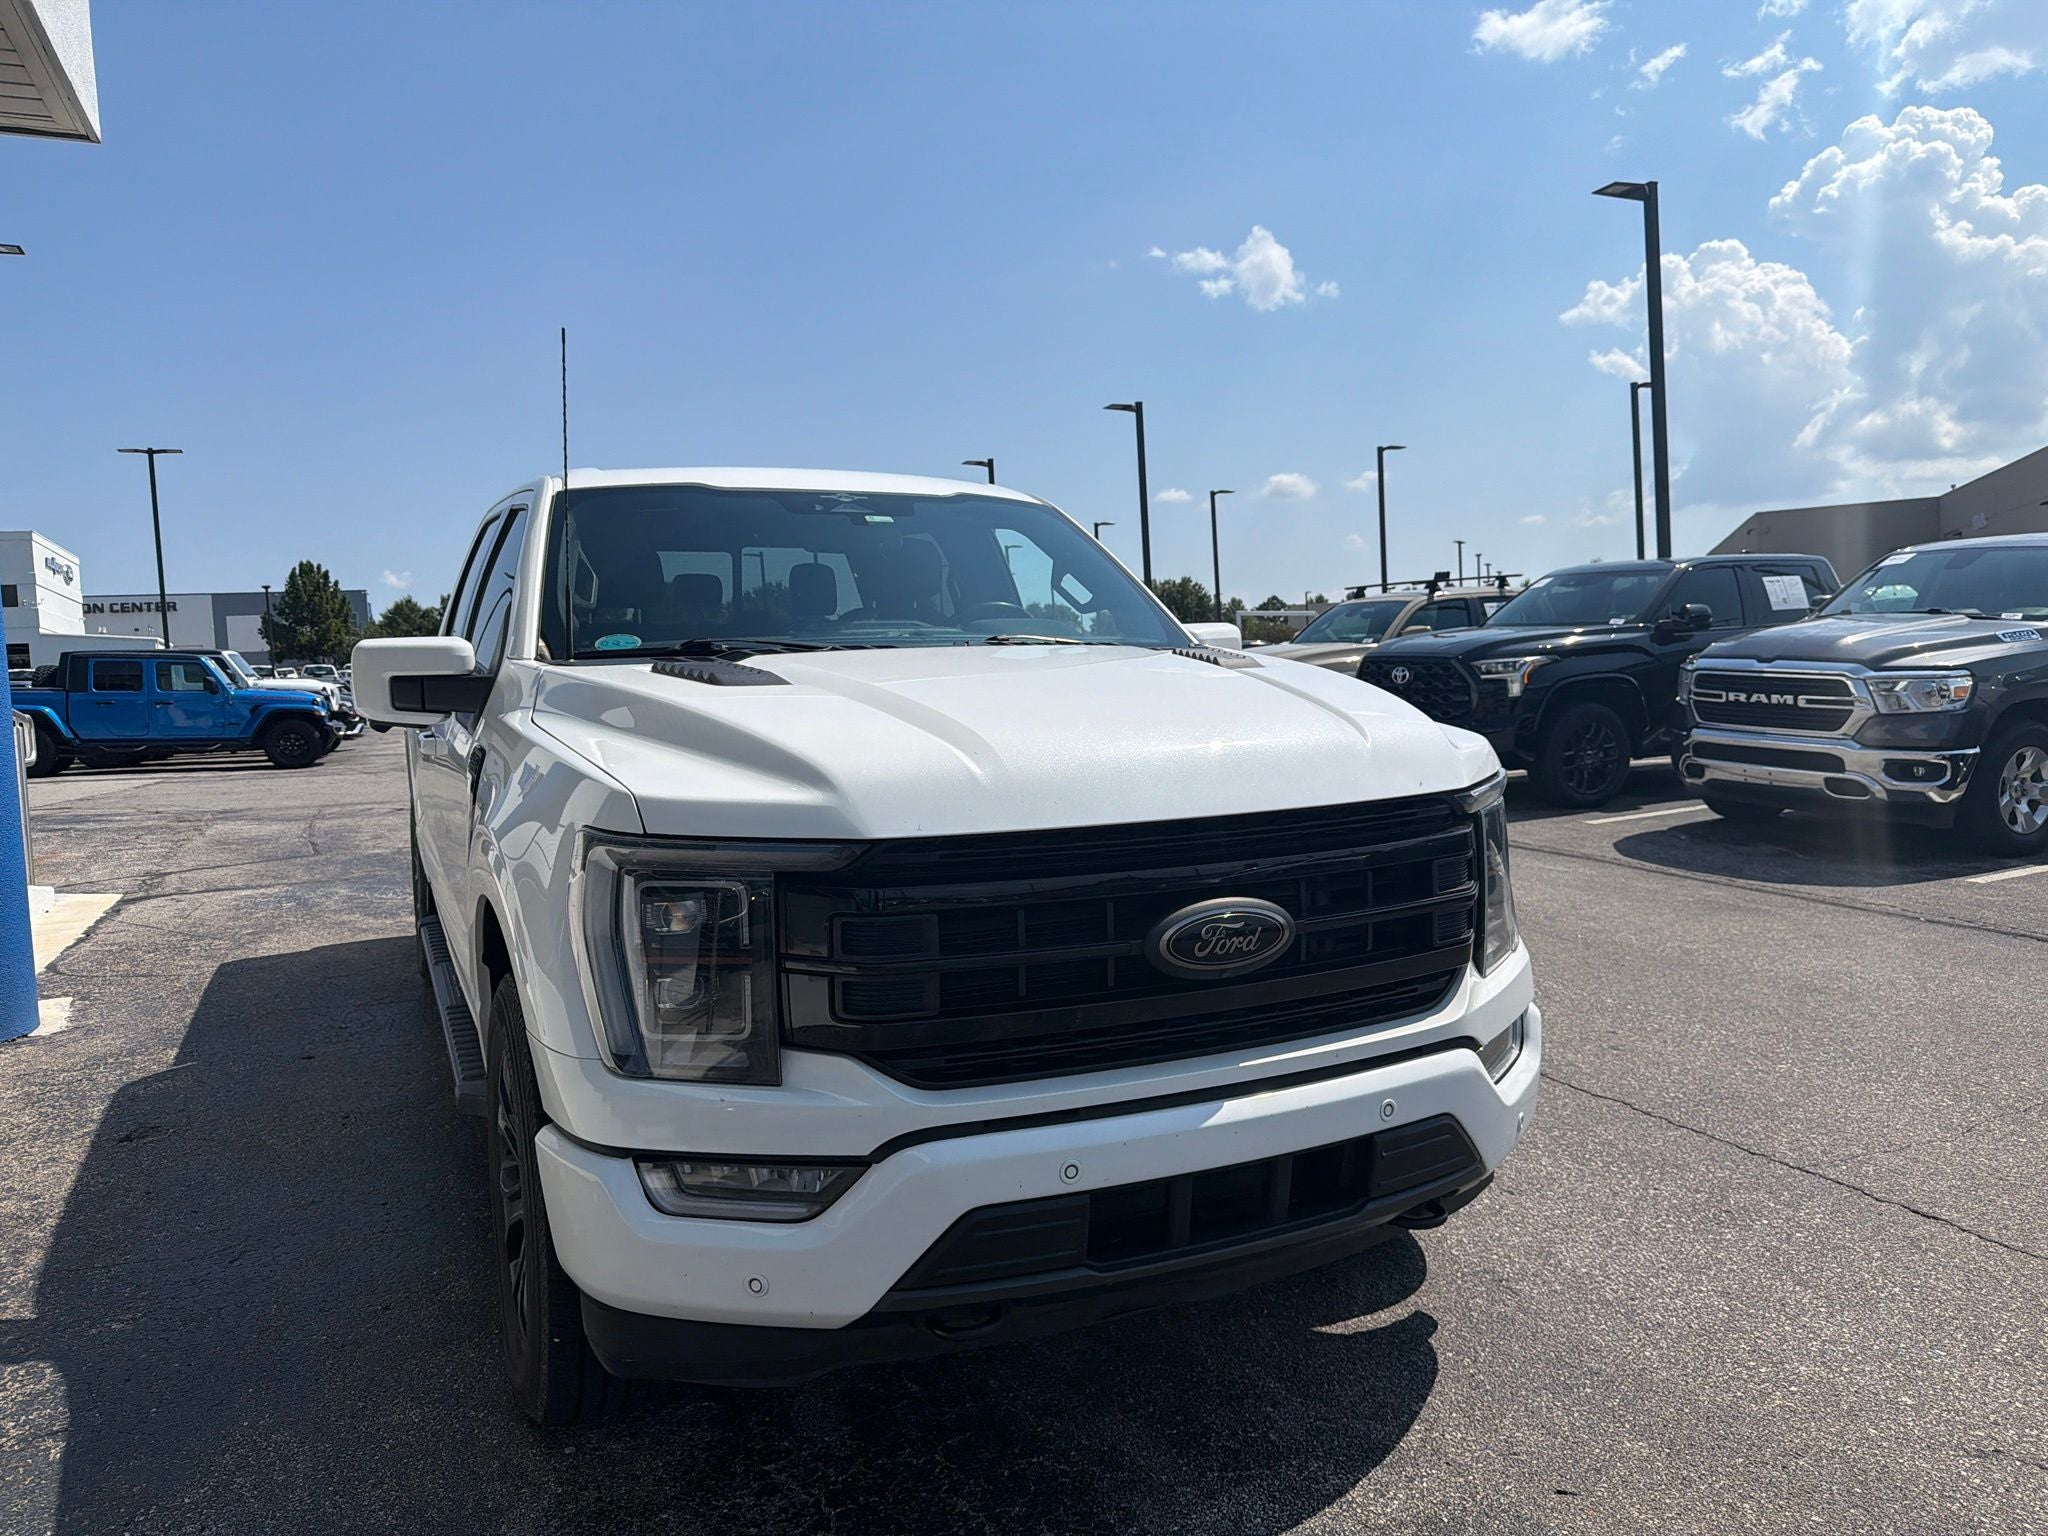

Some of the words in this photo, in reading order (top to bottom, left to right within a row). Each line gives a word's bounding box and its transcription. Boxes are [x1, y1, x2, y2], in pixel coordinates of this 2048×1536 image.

[109, 601, 178, 613] CENTER
[1728, 692, 1794, 705] RAM
[1194, 921, 1262, 958] Ford
